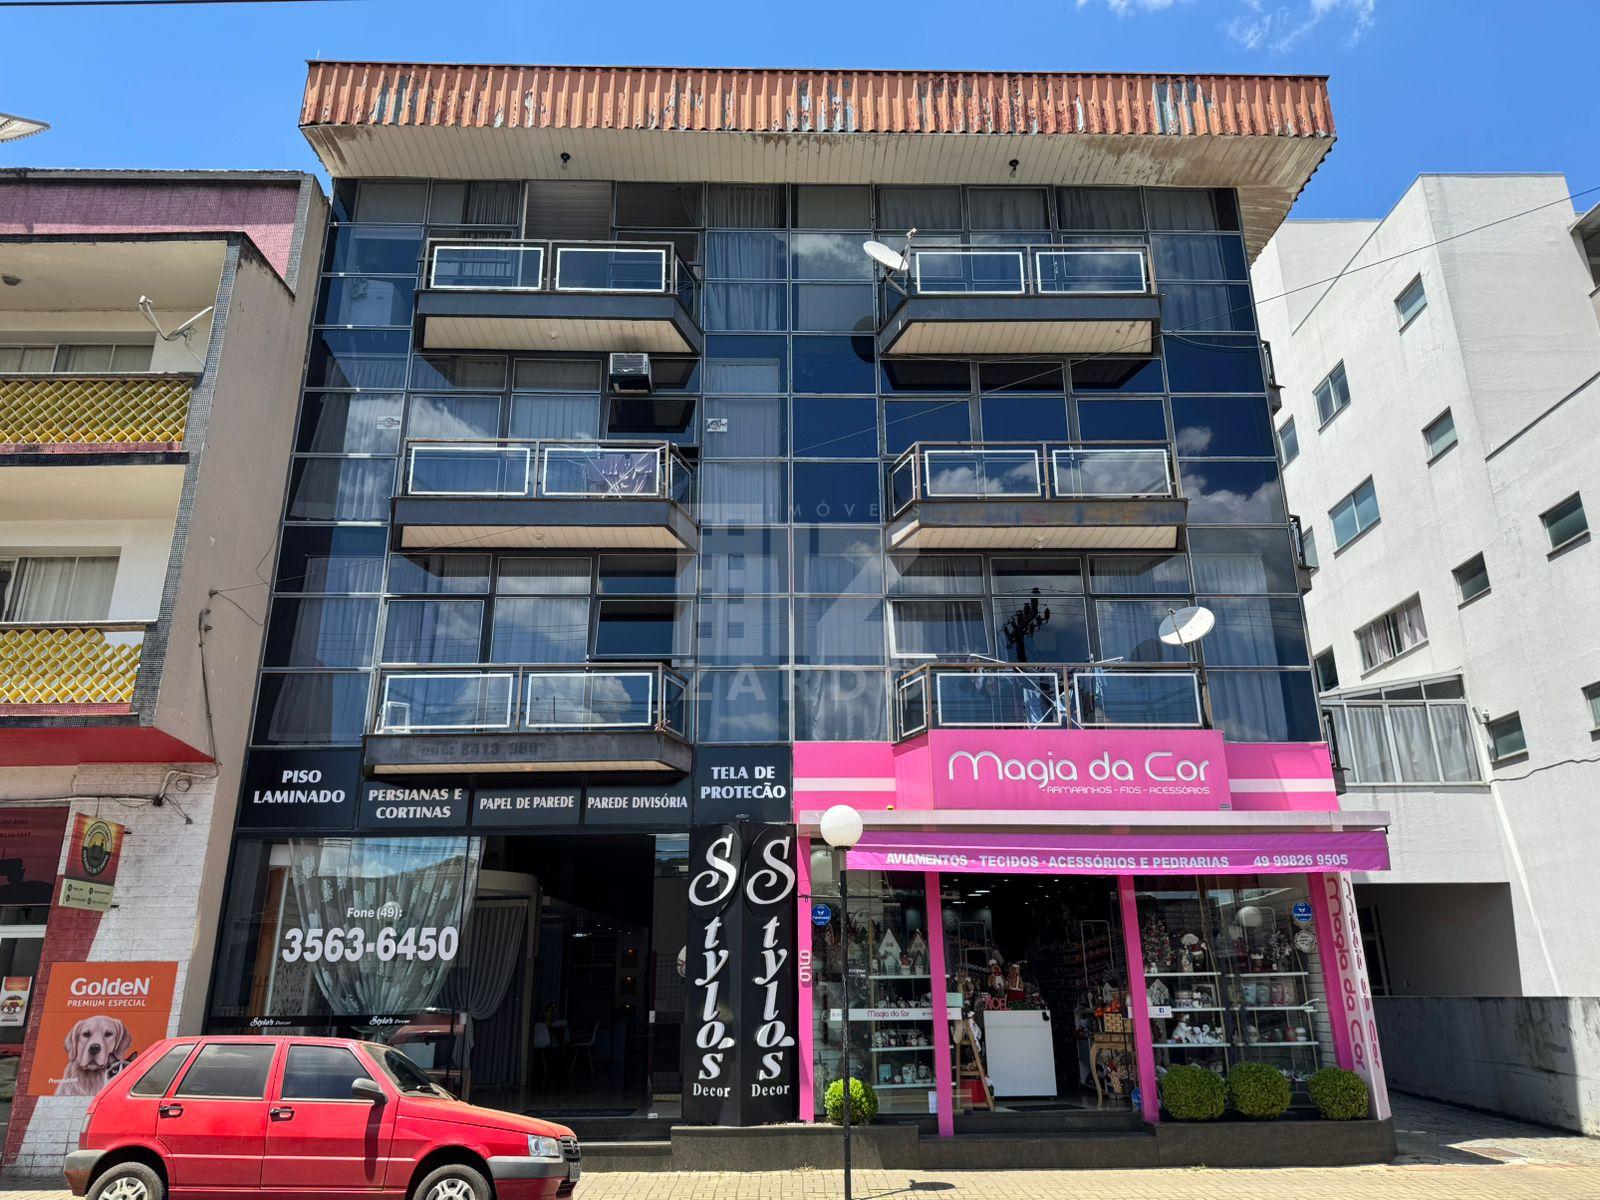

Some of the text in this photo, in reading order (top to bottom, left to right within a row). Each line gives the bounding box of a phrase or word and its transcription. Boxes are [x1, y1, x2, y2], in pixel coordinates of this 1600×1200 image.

[281, 769, 322, 783] PISO
[711, 765, 775, 779] TELA DE
[949, 752, 1210, 788] Magia da Cor
[253, 789, 345, 804] LAMINADO
[368, 788, 463, 801] PERSIANAS E
[1120, 786, 1141, 794] FIOS
[480, 795, 575, 810] PAPEL DE PAREDE
[587, 793, 688, 809] PAREDE DIVISÓRIA
[376, 806, 451, 819] CORTINAS
[885, 852, 968, 866] AVIAMENTOS
[979, 855, 1039, 868] TECIDOS
[1048, 854, 1136, 868] ACESSÓRIOS
[1140, 857, 1149, 868] E
[1152, 856, 1229, 869] PEDRARIAS
[1253, 853, 1348, 867] 49 99826 9505
[347, 907, 402, 919] Fone (49):
[282, 926, 459, 963] 3563-6450
[70, 977, 151, 996] GoldeN
[67, 999, 147, 1008] PREMIUM ESPECIAL
[1343, 978, 1357, 1012] da
[1350, 1019, 1366, 1071] Cor
[693, 1083, 731, 1098] Decor
[751, 1083, 790, 1098] Decor
